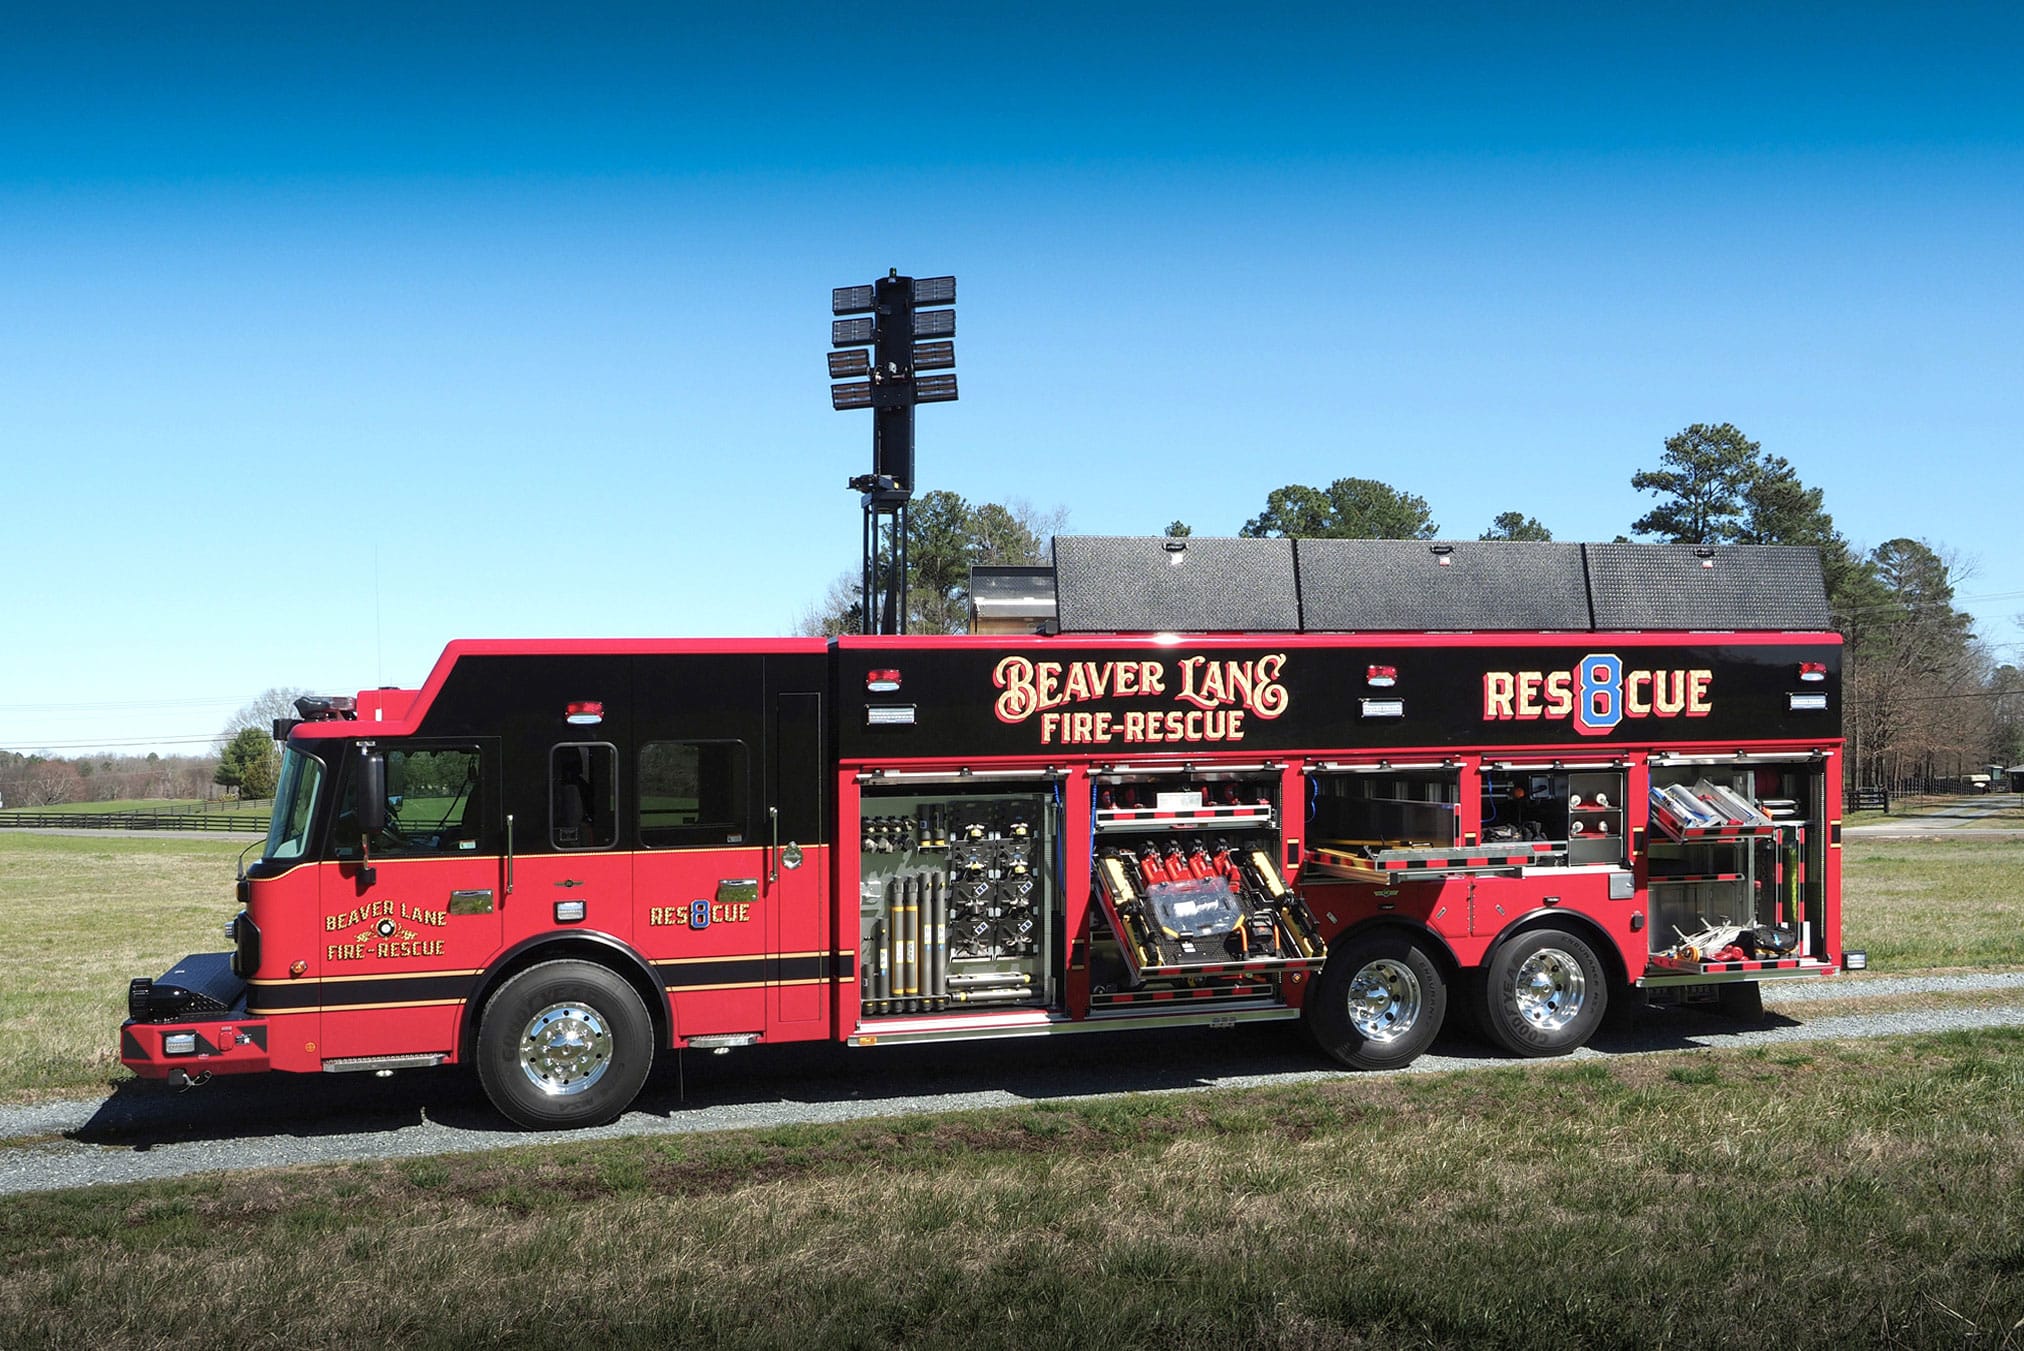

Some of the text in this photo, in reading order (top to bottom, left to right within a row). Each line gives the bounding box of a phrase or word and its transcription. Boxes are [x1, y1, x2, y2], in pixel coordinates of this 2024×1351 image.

[992, 652, 1289, 724] BEAVER LANE
[1041, 710, 1246, 744] FIRE-RESCUE
[325, 899, 447, 932] BEAVER LANE
[326, 940, 446, 961] FIRE-RESCUE
